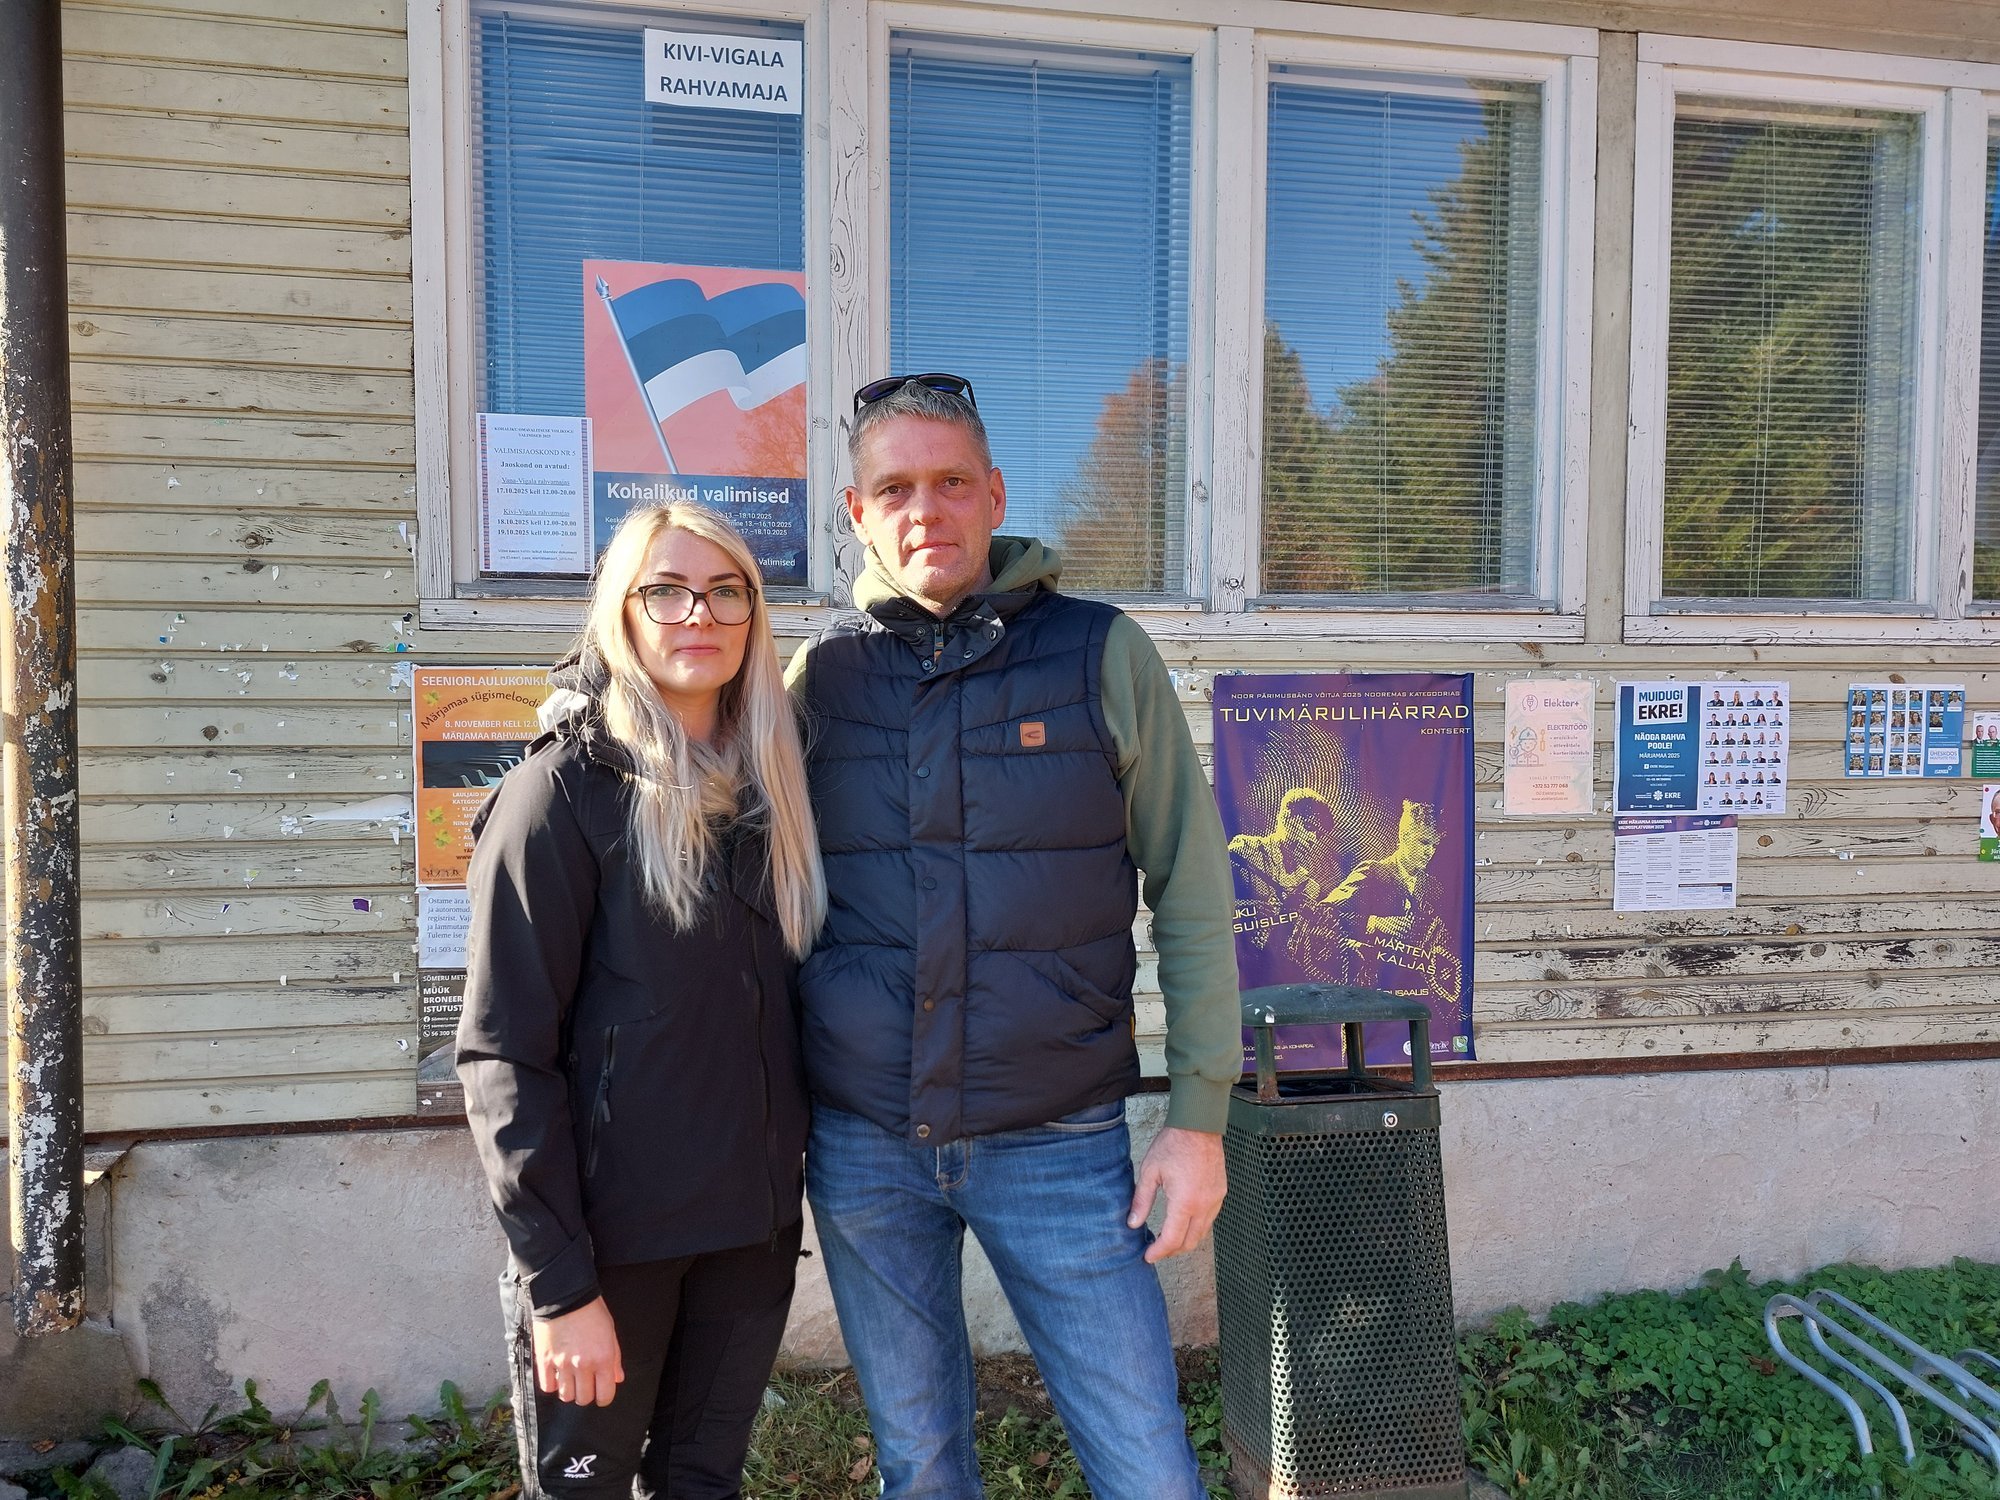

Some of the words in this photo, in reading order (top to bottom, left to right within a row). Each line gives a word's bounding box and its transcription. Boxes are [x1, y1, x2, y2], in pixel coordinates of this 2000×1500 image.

[664, 42, 784, 68] KIVI-VIGALA
[660, 76, 788, 102] RAHVAMAJA
[494, 447, 560, 456] VALIMISJAOSKOND
[500, 461, 533, 469] Jaoskond
[502, 477, 537, 486] Vana-Vigala
[538, 478, 570, 487] rahvamajas
[607, 482, 698, 501] Kohalikud
[703, 486, 790, 504] valimised
[503, 508, 537, 516] Kivi-Vigala
[497, 518, 530, 526] 18.10.2025
[758, 557, 796, 567] Valimised
[1639, 690, 1683, 702] MUIDUGI
[1543, 698, 1580, 708] Elekter+
[420, 697, 468, 730] Märjamaa
[470, 690, 541, 709] sügismeloodi
[1220, 702, 1469, 722] TUVIMÄRULIHÄRRAD
[1638, 704, 1682, 720] EKRE!
[444, 720, 453, 728] 8.
[454, 720, 501, 728] NOVEMBER
[502, 720, 521, 728] KELL
[523, 720, 540, 728] 12.0
[1547, 722, 1588, 731] ELEKTRITÖÖD
[442, 731, 490, 740] MÄRJAMAA
[1420, 727, 1471, 735] KONTSERT
[1648, 742, 1673, 750] POOLE!
[1233, 912, 1301, 933] SUISLEP
[1374, 936, 1434, 958] MÄRTEN
[1377, 952, 1437, 975] KALJAS
[422, 974, 450, 982] SÕMERU
[423, 986, 450, 994] MÜÜK
